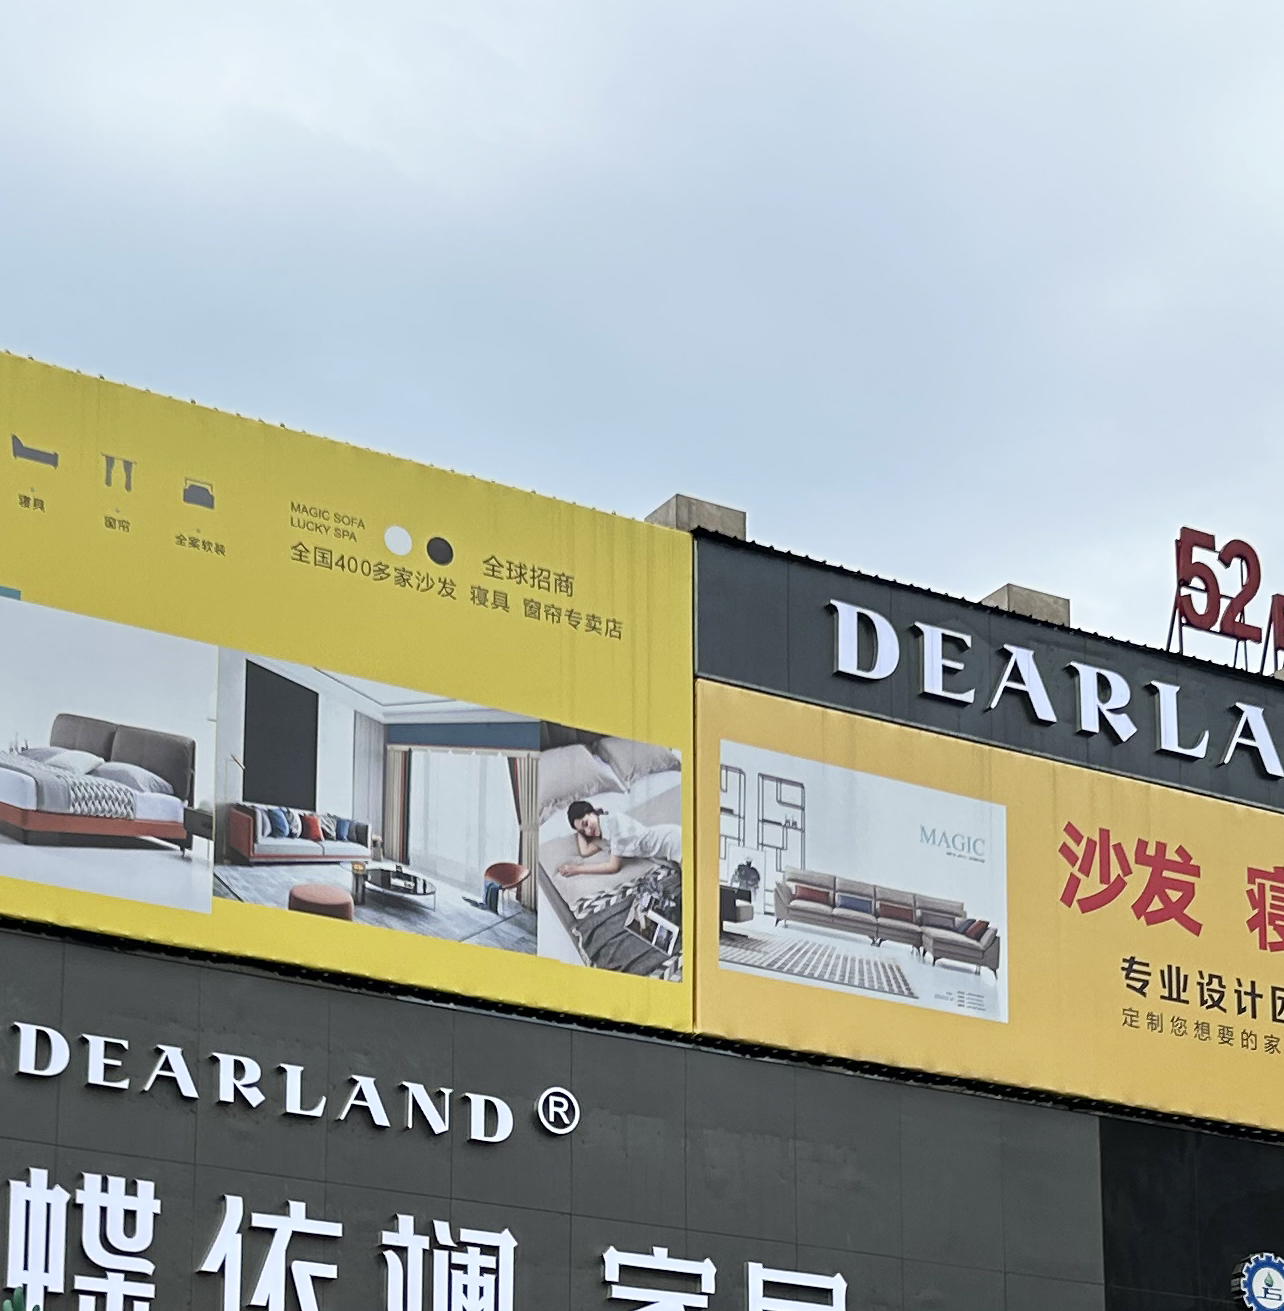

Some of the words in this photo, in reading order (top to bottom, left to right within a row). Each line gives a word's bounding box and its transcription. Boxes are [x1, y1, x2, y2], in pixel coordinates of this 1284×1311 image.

[290, 501, 330, 522] MAGIC
[333, 512, 366, 530] SOFA
[290, 516, 331, 536] LUCKY
[333, 527, 357, 543] SPA
[174, 533, 227, 557] 全案软装
[290, 541, 457, 601] 全国400多家沙发
[470, 585, 510, 614] 寝具
[522, 598, 623, 641] 窗帘专卖店
[482, 555, 575, 598] 全球招商
[919, 825, 986, 856] MAGIC
[1059, 820, 1202, 936] 沙发
[12, 1020, 514, 1147] DEARLAND
